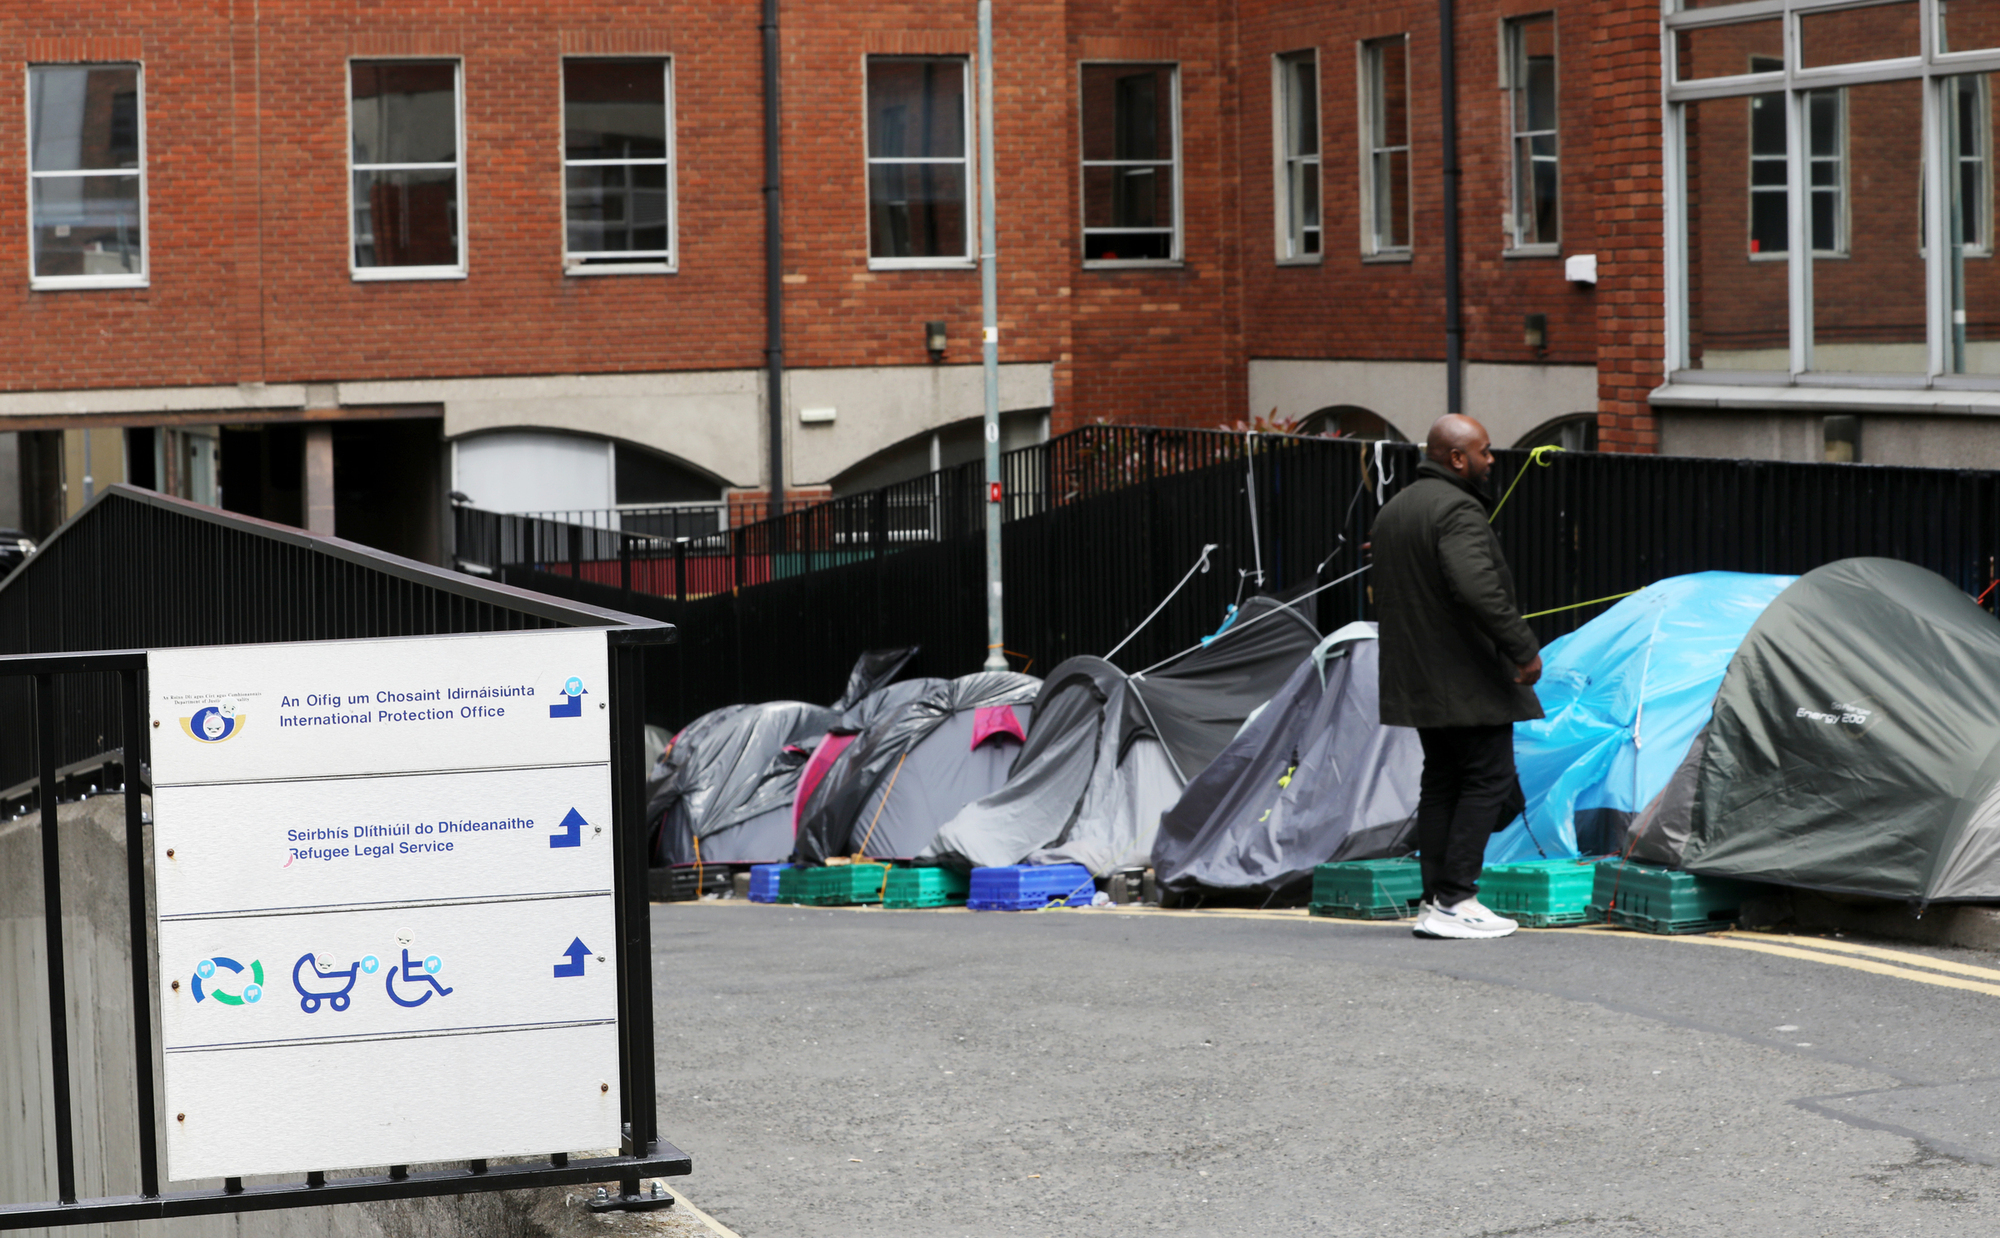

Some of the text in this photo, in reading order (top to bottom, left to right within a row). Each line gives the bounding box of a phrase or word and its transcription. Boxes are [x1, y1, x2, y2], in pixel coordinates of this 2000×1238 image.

[281, 685, 535, 708] An Oifig um Chosaint Idirnáisiúnta
[280, 706, 505, 727] International Protection Office
[1796, 707, 1866, 724] Energy 200
[287, 818, 534, 841] Seirbhís Dlíthiúil do Dhídeanaithe
[354, 843, 394, 858] Legal
[399, 840, 454, 853] Service
